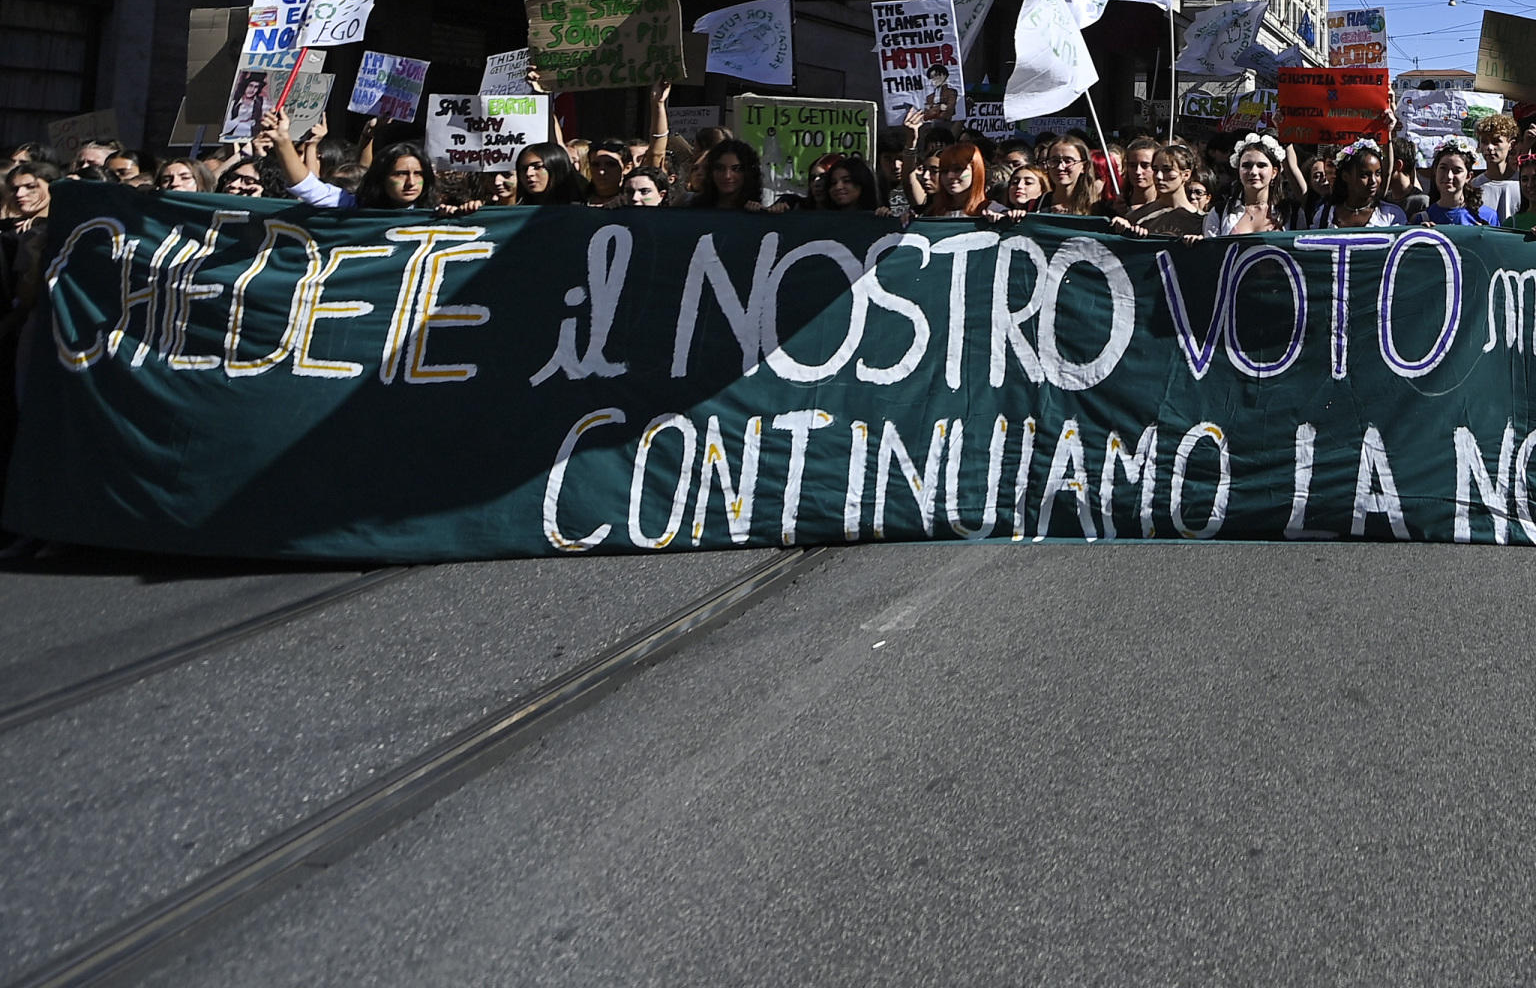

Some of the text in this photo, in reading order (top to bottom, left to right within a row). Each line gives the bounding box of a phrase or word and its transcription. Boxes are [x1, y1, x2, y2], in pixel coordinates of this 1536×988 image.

[541, 1, 567, 22] LE
[873, 5, 905, 18] THE
[312, 19, 360, 42] EGO
[878, 13, 949, 32] PLANET IS
[1327, 17, 1345, 28] OUR
[547, 24, 620, 49] SONO
[881, 29, 944, 48] GETTING
[1331, 31, 1340, 45] IS
[490, 53, 515, 67] THIS
[516, 50, 530, 60] PLA
[881, 44, 958, 71] HOTTER
[557, 67, 603, 88] MIO
[884, 75, 924, 93] THAN
[1279, 73, 1335, 85] GIUSTIZIA
[435, 97, 537, 117] SAVE EARTH
[746, 105, 868, 127] IT IS GETTING
[978, 102, 1004, 117] CLIM
[465, 117, 505, 133] TODAY
[451, 131, 527, 147] TO SURVIVE
[792, 130, 868, 150] TOO HOT
[446, 149, 515, 168] TOMORROW
[529, 223, 632, 388] il
[672, 230, 1136, 391] NOSTRO
[1156, 228, 1462, 381] VOTO
[543, 408, 1231, 553] CONTINUIAMO
[1284, 422, 1409, 540] LA
